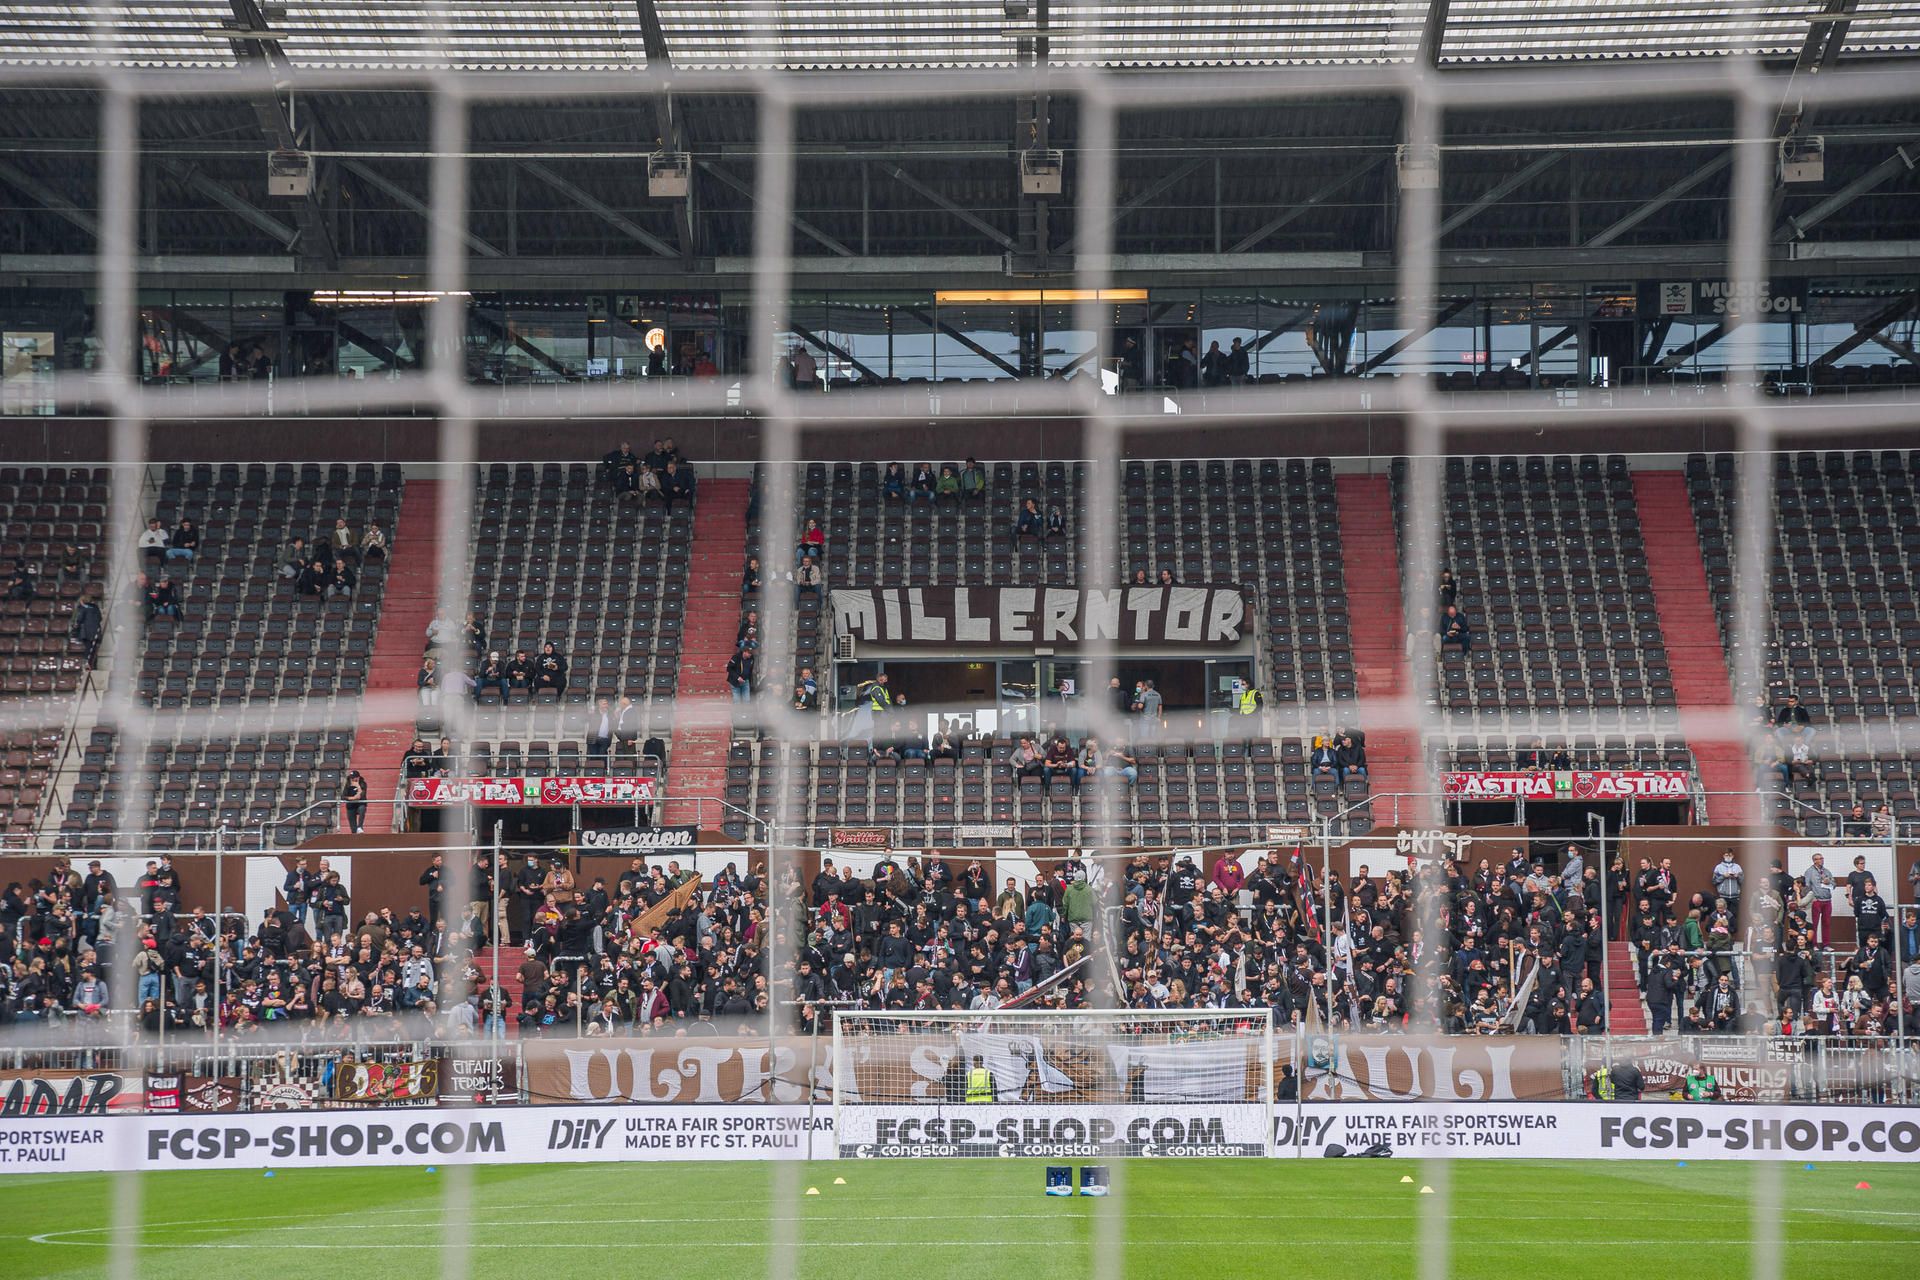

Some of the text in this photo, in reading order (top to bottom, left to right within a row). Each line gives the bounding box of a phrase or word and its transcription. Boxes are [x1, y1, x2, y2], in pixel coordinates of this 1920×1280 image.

[1700, 282, 1770, 298] MUSIC
[1713, 296, 1802, 313] SCHOOL
[830, 586, 1244, 642] MILLERNTOR
[433, 784, 521, 800] ASTRA
[563, 784, 652, 800] ASTRA
[1464, 777, 1553, 795] ASTRA
[1597, 777, 1687, 794] ASTRA
[1766, 1039, 1801, 1051] METT
[1647, 1075, 1670, 1084] PAULI
[625, 1117, 833, 1131] ULTRA FAIR SPORTSWEAR
[1345, 1115, 1557, 1129] ULTRA FAIR SPORTSWEAR
[876, 1118, 1226, 1145] FCSP-SHOP.COM
[1345, 1132, 1521, 1146] MADE BY FC ST. PAULI
[147, 1121, 505, 1160] FCSP-SHOP.COM
[625, 1134, 798, 1149] MADE BY FC ST. PAULI
[17, 1148, 65, 1162] PAULI
[881, 1143, 958, 1158] congstar
[1024, 1143, 1100, 1157] congstar
[1167, 1144, 1243, 1157] congstar
